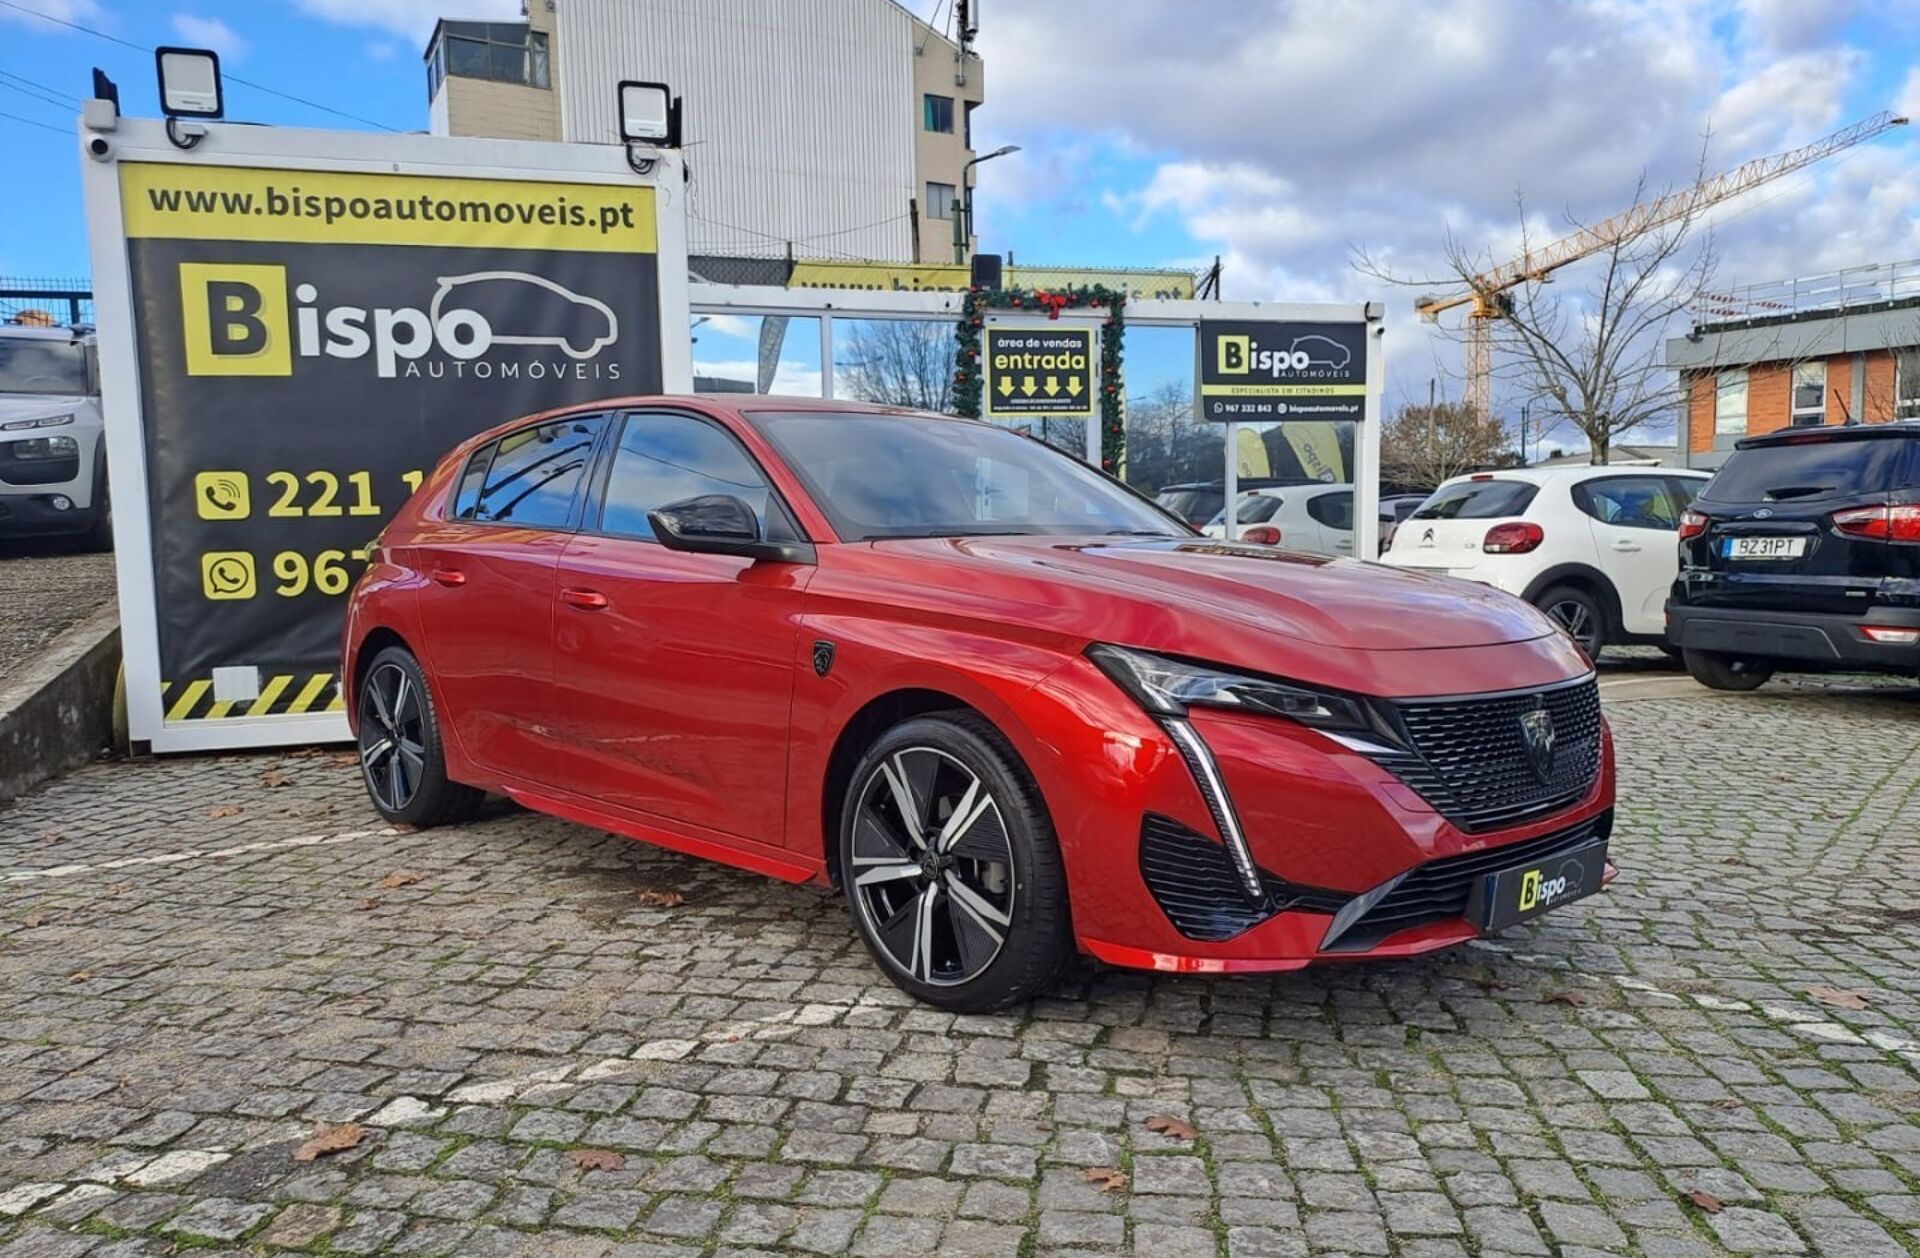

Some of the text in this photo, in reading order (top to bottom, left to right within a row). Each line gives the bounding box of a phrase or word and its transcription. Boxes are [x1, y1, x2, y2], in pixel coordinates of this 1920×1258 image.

[149, 186, 635, 233] www.bispoautomoveis.pt
[207, 280, 492, 378] Bispo
[997, 338, 1082, 348] área de vendas
[405, 359, 621, 380] AUTOMÓVEIS
[994, 351, 1086, 369] entrada
[1225, 341, 1310, 378] Bispo
[1279, 368, 1351, 378] AUTOMÓVEIS
[268, 470, 381, 517] 221
[1738, 539, 1794, 554] BZ31PT
[273, 549, 368, 597] 96
[1524, 873, 1566, 906] Bispo
